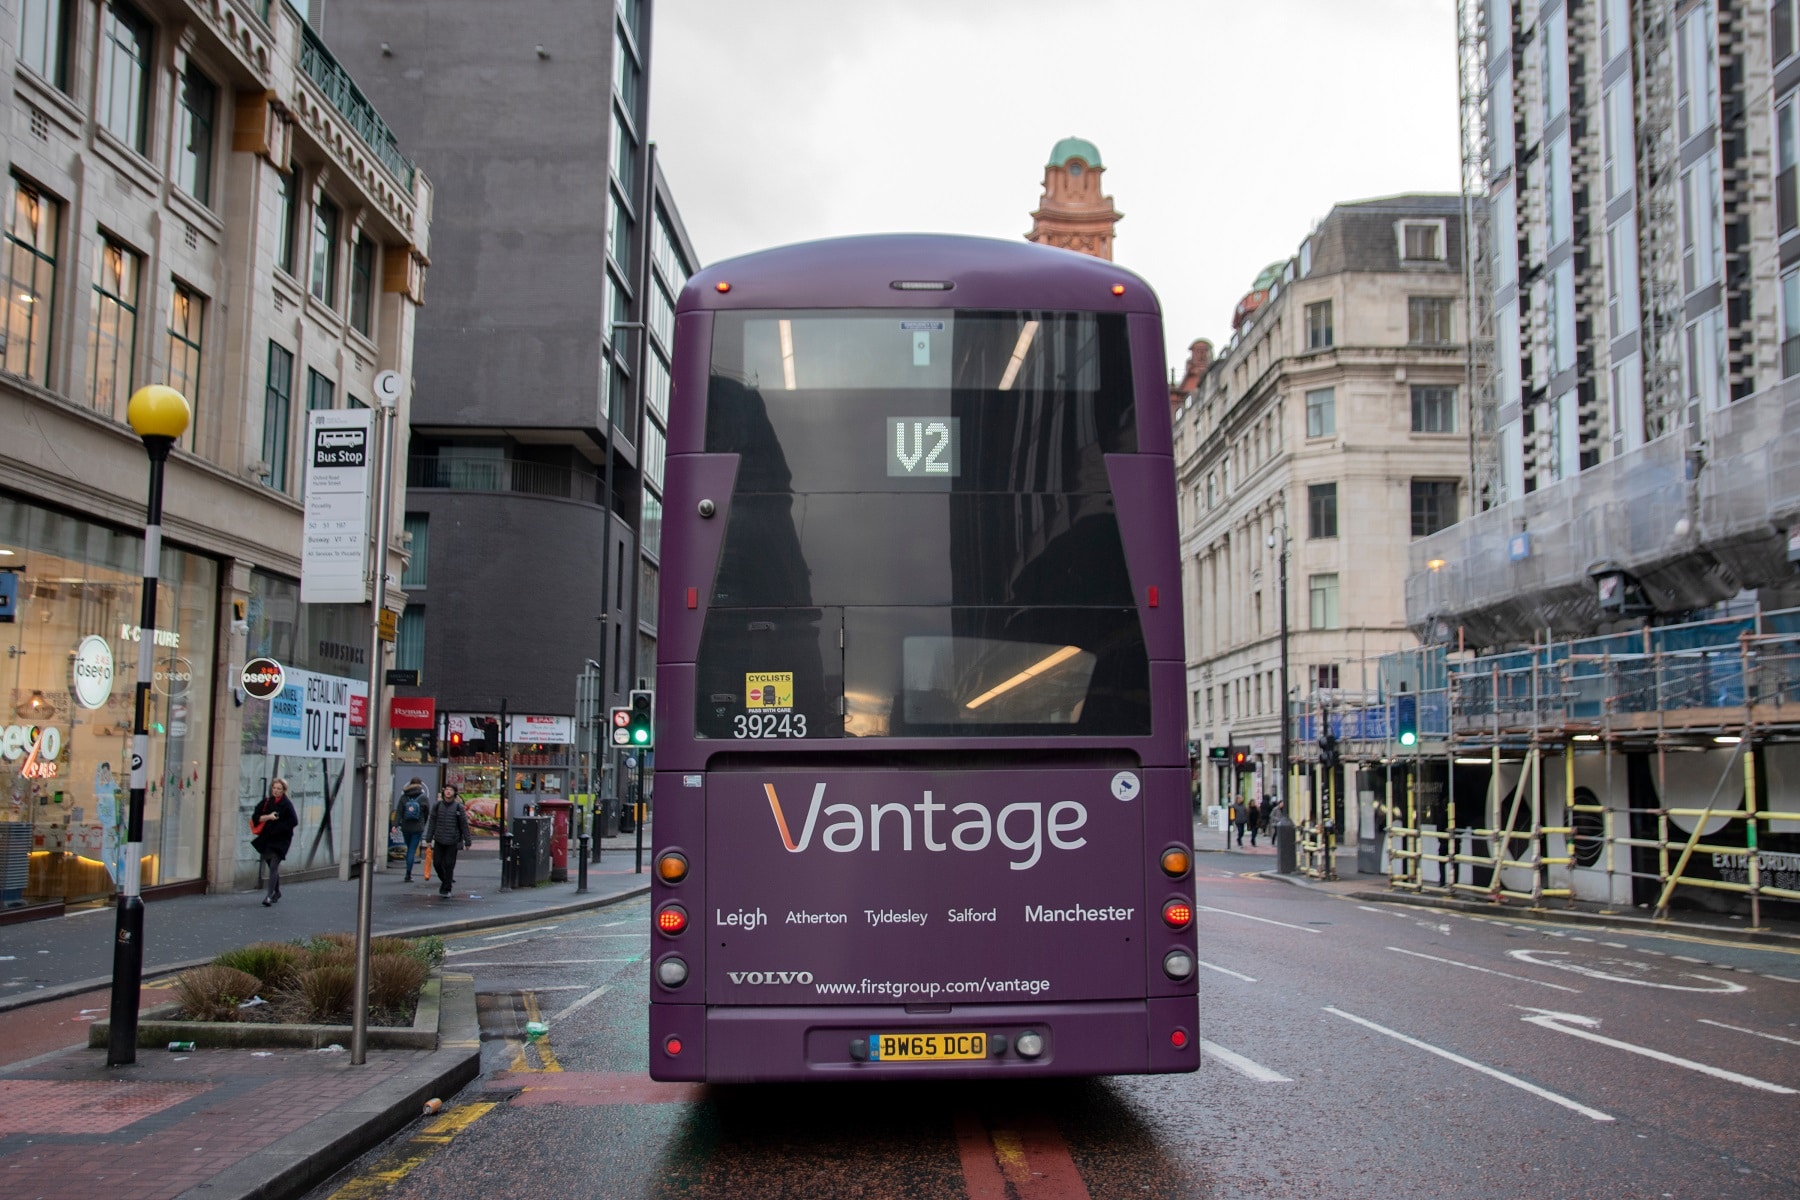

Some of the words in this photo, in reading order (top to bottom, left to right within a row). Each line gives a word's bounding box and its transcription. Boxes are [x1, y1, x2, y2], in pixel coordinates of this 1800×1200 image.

[382, 375, 395, 394] C
[317, 450, 337, 463] Bus
[338, 450, 363, 465] Stop
[896, 422, 949, 472] V2
[748, 674, 791, 682] CYCLISTS
[307, 677, 331, 704] RETAIL
[332, 681, 348, 706] UNIT
[273, 701, 297, 716] HARRIS
[305, 708, 321, 751] TO
[324, 710, 347, 753] LET
[733, 713, 808, 739] 39243
[763, 782, 1089, 871] Vantage
[716, 907, 768, 931] Leigh
[785, 910, 848, 924] Atherton
[864, 909, 928, 926] Tyldesley
[947, 907, 997, 922] Salford
[1024, 903, 1135, 923] Manchester
[727, 971, 814, 985] VOLVO
[815, 977, 1051, 998] www.firstgroup.com/vantage
[884, 1037, 938, 1056] BW65
[943, 1036, 983, 1055] DCO
